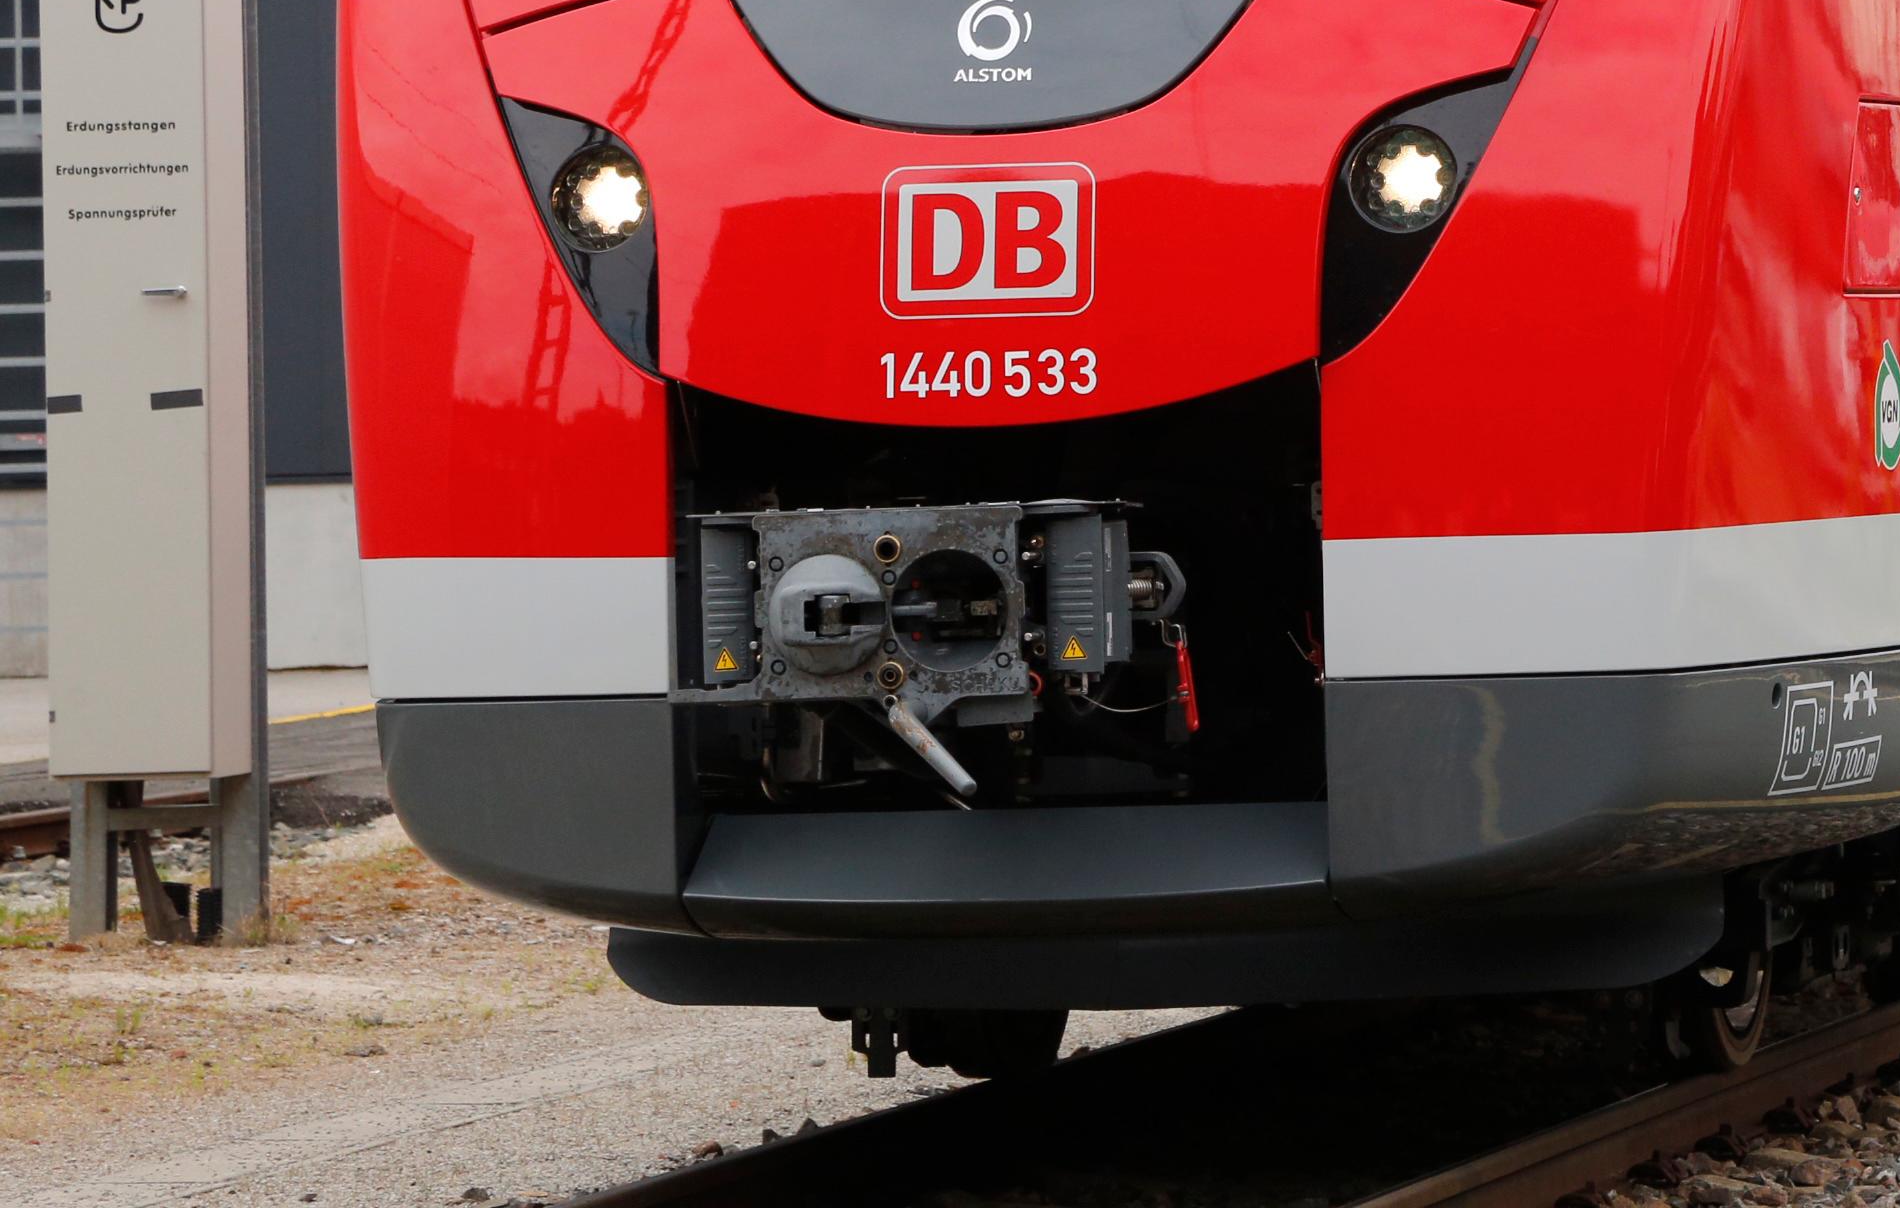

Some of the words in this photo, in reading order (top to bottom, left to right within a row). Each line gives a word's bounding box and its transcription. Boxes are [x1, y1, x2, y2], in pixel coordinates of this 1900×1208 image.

[953, 67, 1032, 83] ALSTOM
[65, 120, 176, 134] Erdungsstangen
[55, 162, 190, 178] Erdungsvorrichtungen
[67, 206, 177, 221] Spannungsprüfer
[910, 189, 1067, 292] DB
[879, 349, 991, 400] 1440
[1003, 347, 1099, 397] 533
[1881, 399, 1899, 424] VGN
[1818, 707, 1826, 725] G1
[1792, 726, 1806, 755] G1
[1828, 750, 1842, 783] R
[1841, 746, 1866, 782] 100
[1863, 751, 1877, 777] m
